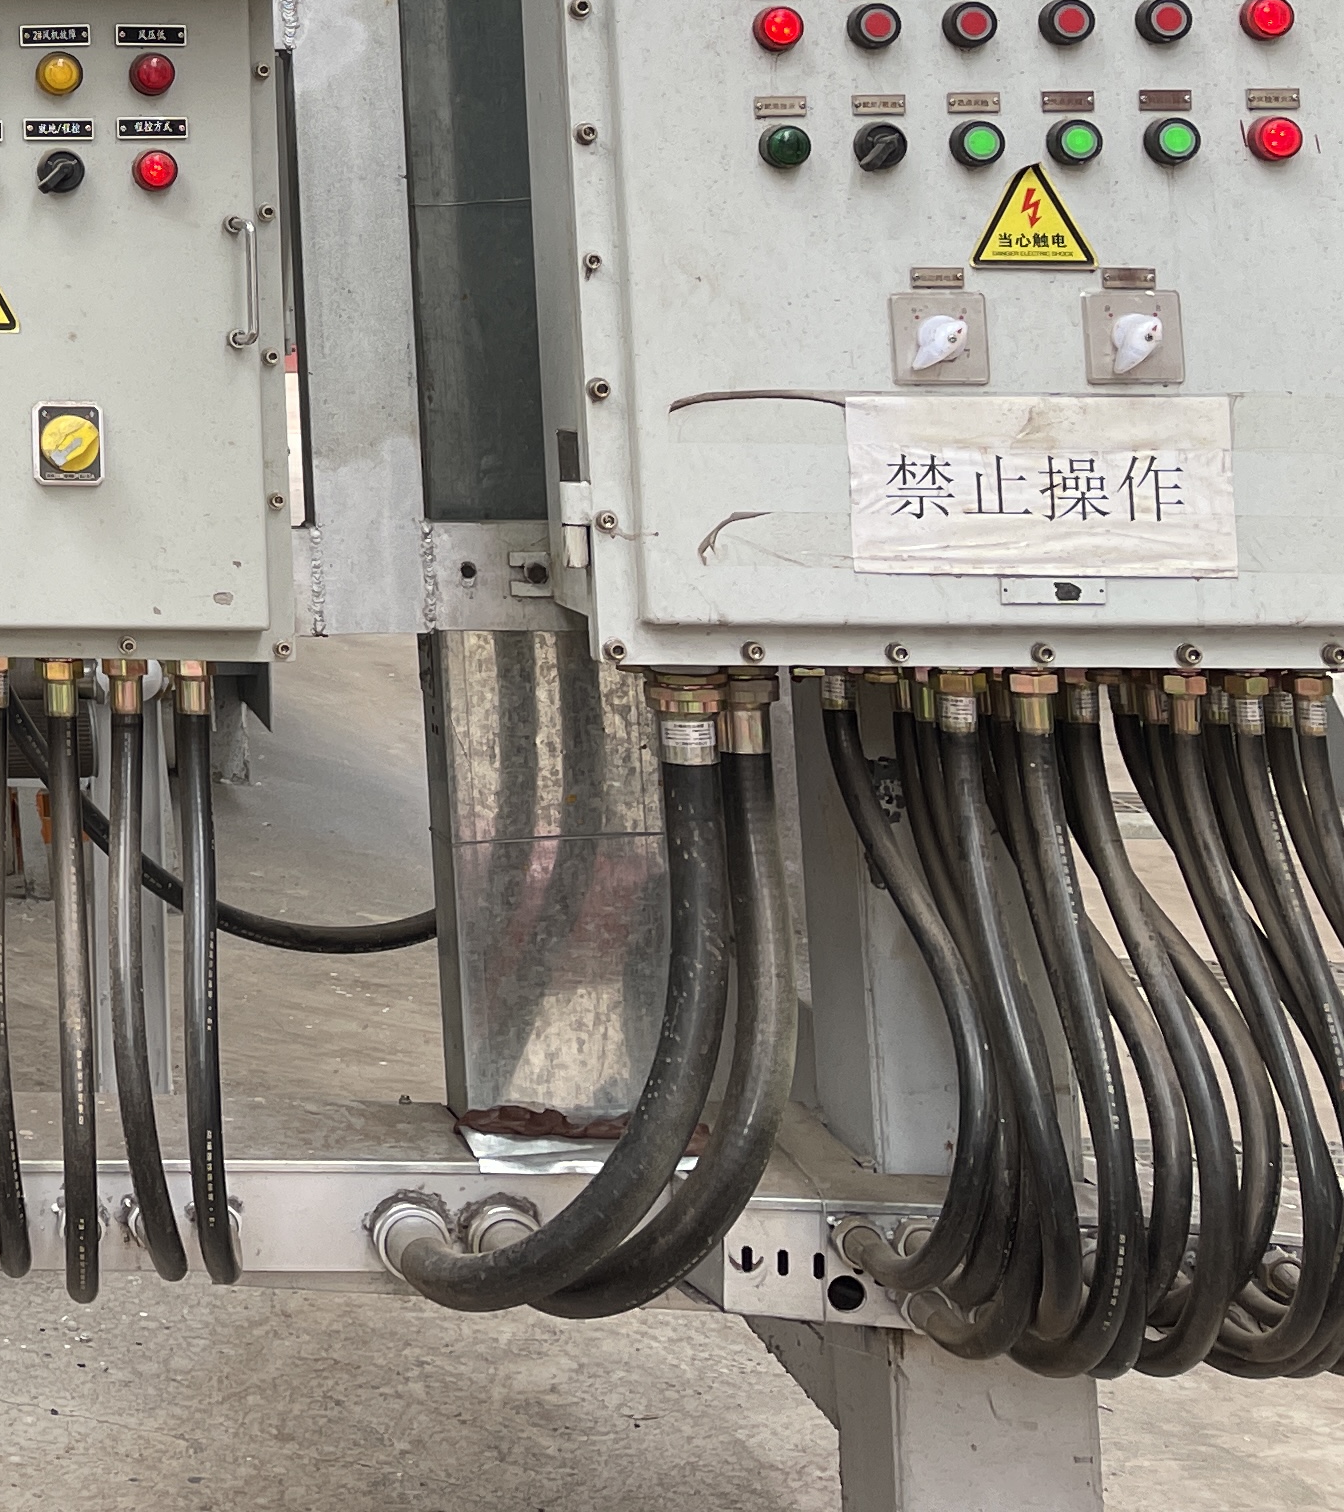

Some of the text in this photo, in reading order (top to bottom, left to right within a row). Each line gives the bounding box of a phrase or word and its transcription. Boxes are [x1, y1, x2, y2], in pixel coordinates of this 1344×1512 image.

[137, 28, 167, 41] 风压低
[134, 121, 173, 133] 程控方式
[998, 231, 1068, 248] 当心触电
[885, 452, 1186, 522] 禁止操作
